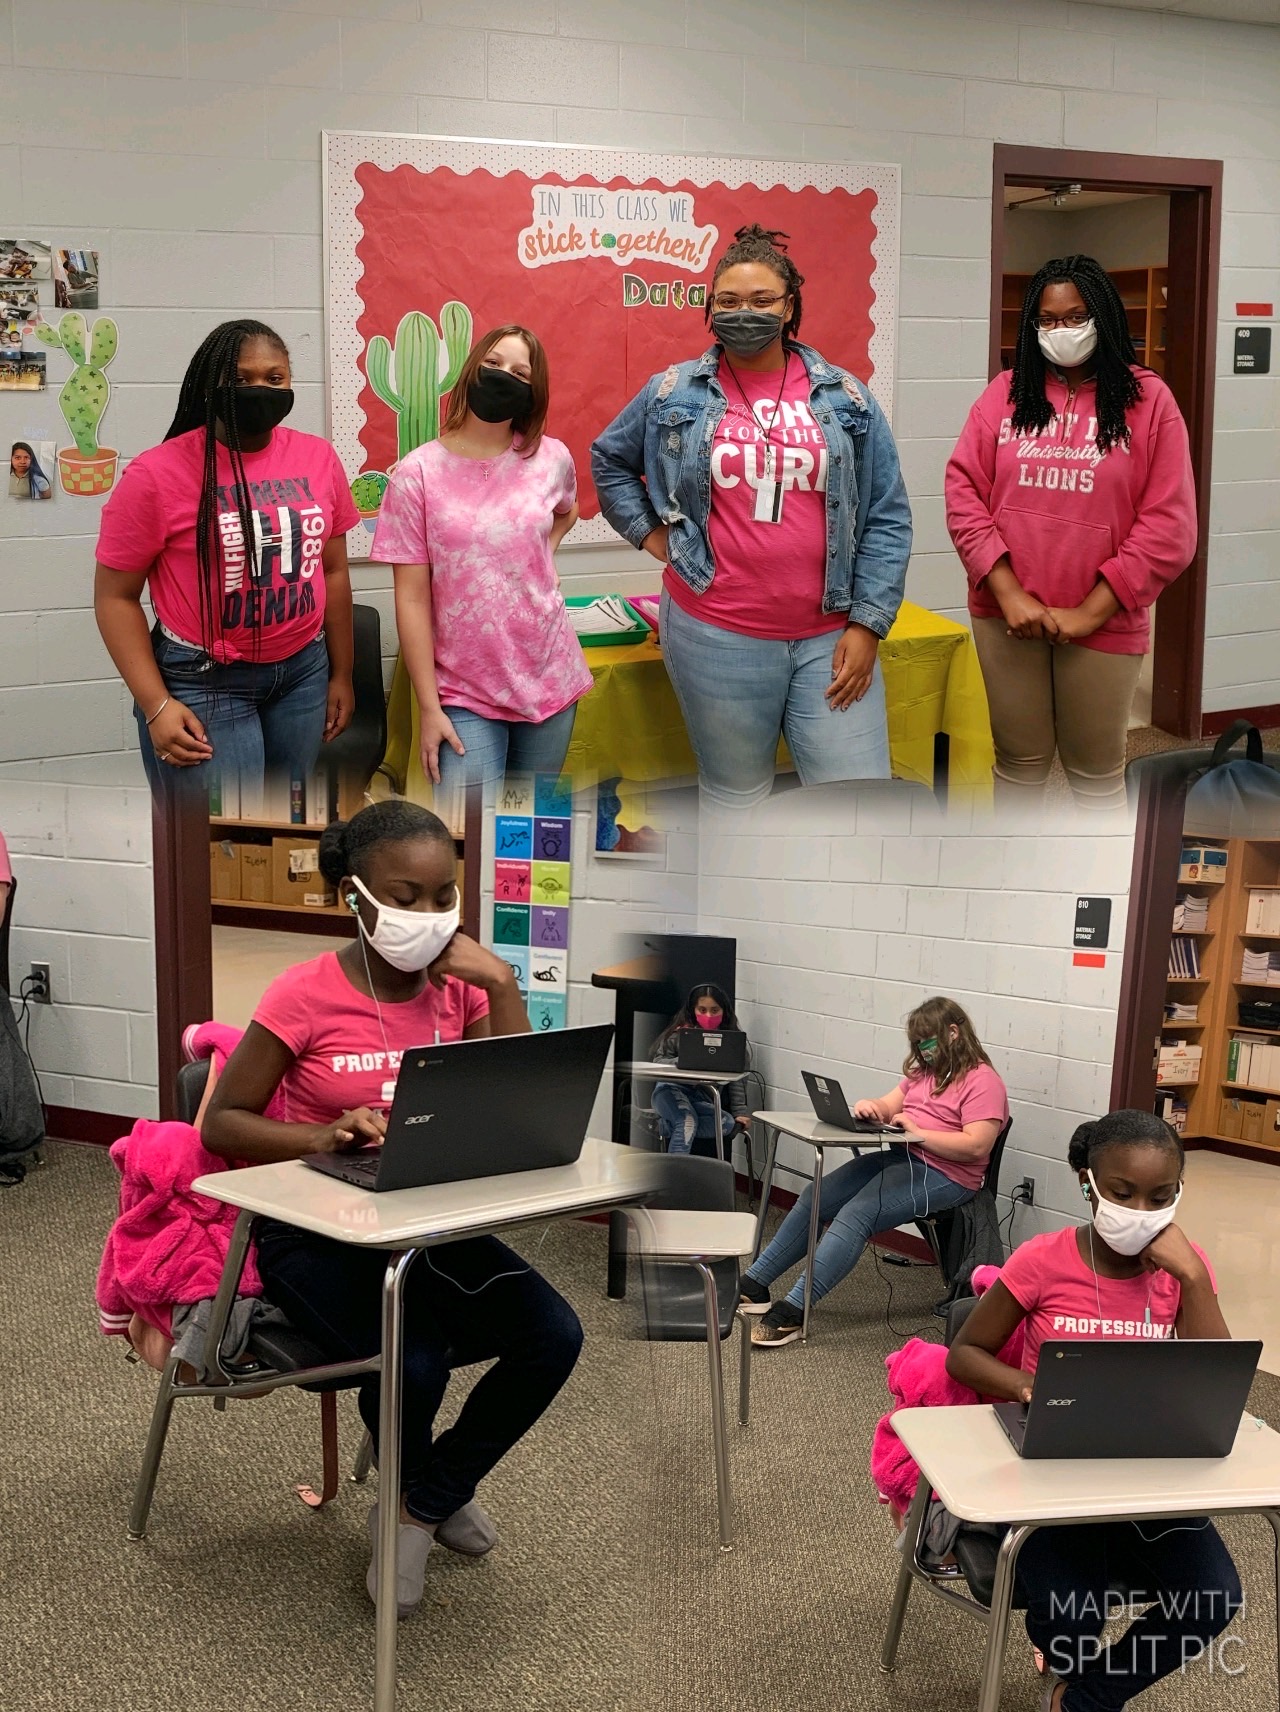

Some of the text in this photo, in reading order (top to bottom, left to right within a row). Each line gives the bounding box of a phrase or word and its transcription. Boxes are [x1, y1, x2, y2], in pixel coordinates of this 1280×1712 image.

[538, 191, 688, 223] IN THIS CLASS WE
[524, 220, 712, 266] stick together!
[623, 273, 707, 309] Data
[1238, 330, 1250, 338] 409
[724, 426, 823, 444] FOR THE
[1016, 440, 1107, 469] University
[1018, 463, 1095, 494] LIONS
[218, 510, 246, 593] HILFIGER
[300, 504, 325, 579] 1985
[222, 581, 316, 630] DENIM
[496, 906, 528, 914] Confidence
[542, 909, 556, 917] Unity
[1078, 900, 1088, 908] 810
[405, 1114, 435, 1125] acer
